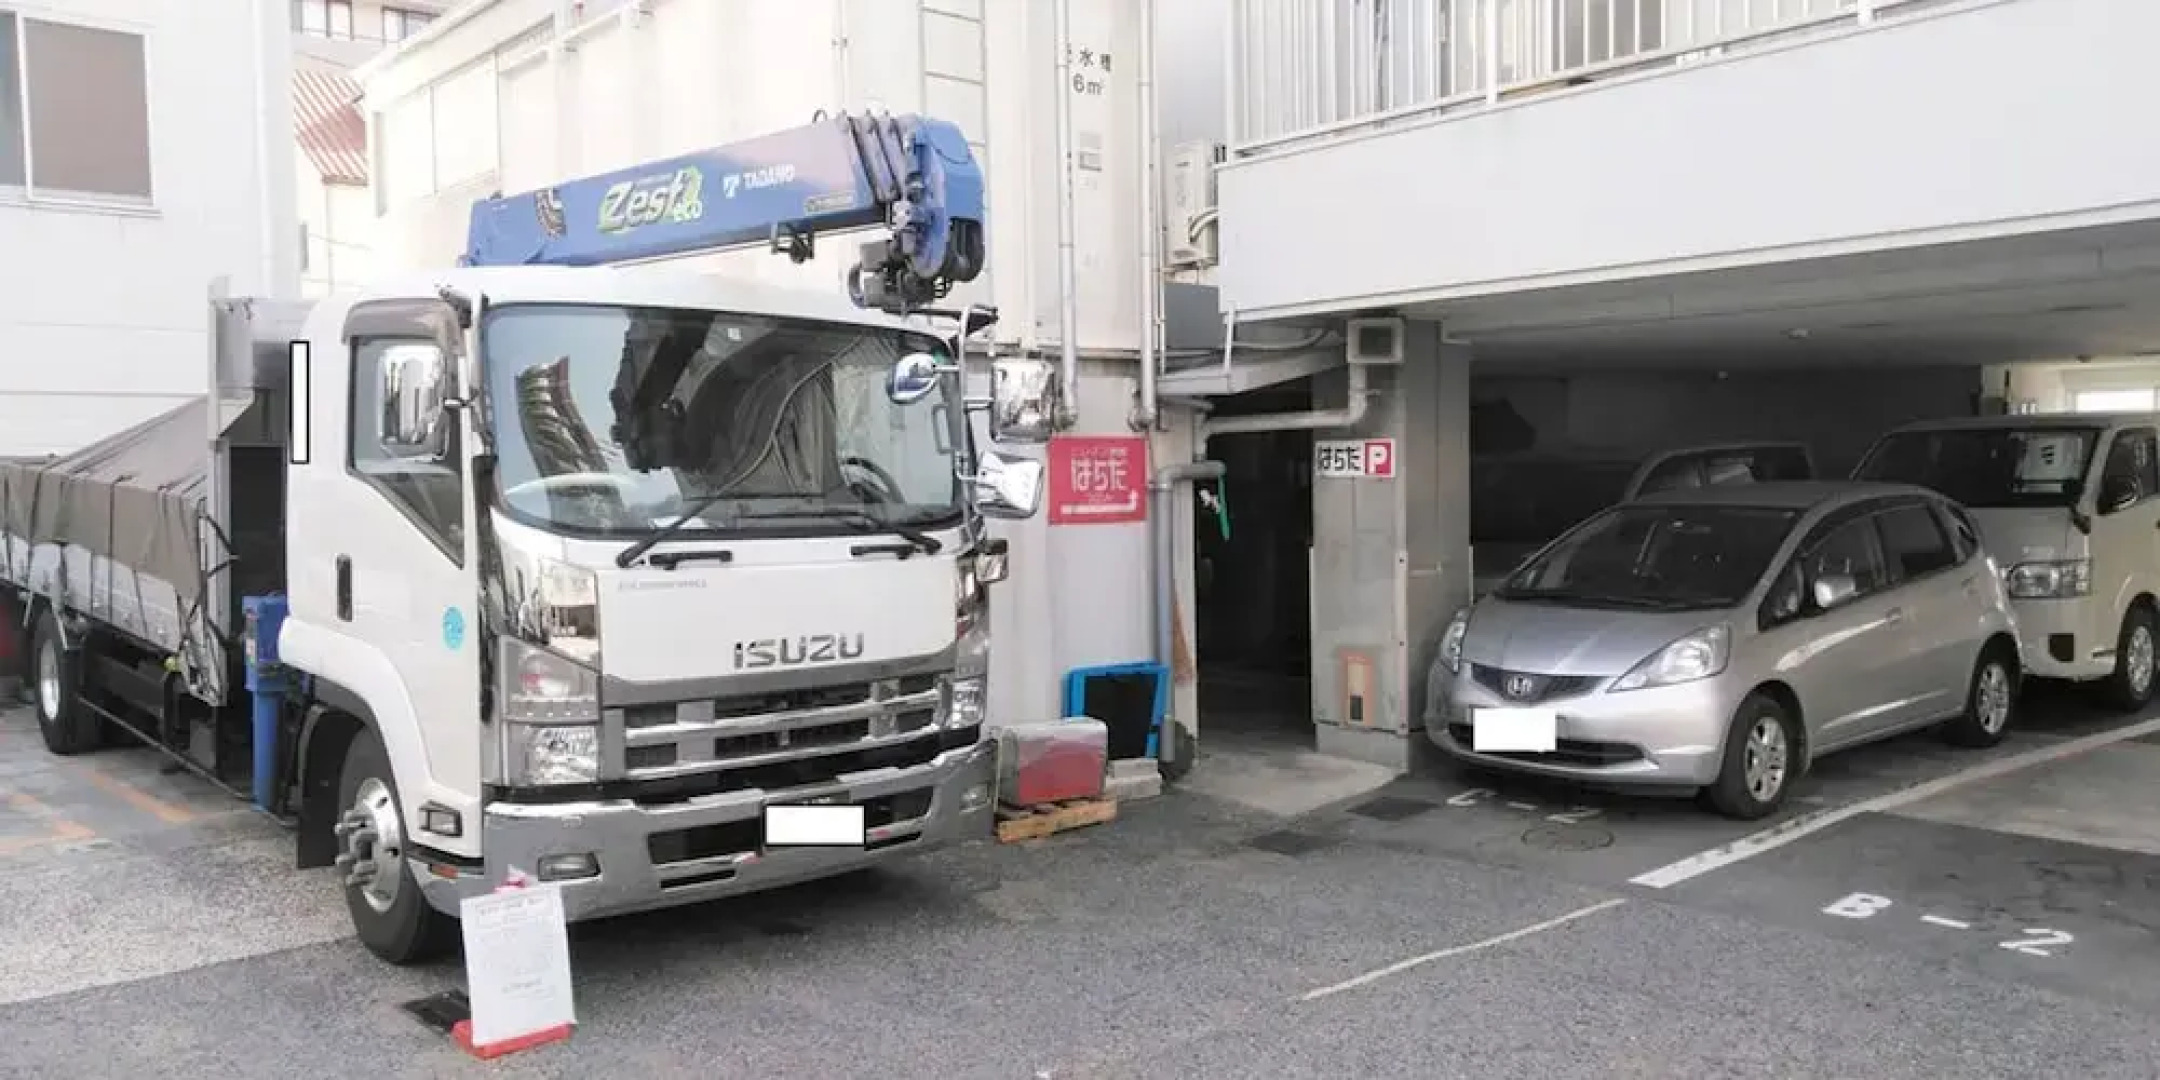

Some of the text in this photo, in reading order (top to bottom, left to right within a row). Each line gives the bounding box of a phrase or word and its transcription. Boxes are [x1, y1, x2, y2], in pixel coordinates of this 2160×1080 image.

[602, 167, 694, 230] Zest
[674, 200, 703, 222] eco
[1070, 457, 1129, 492] はらだ
[1317, 445, 1388, 473] はらだ P
[733, 633, 864, 669] ISUZU
